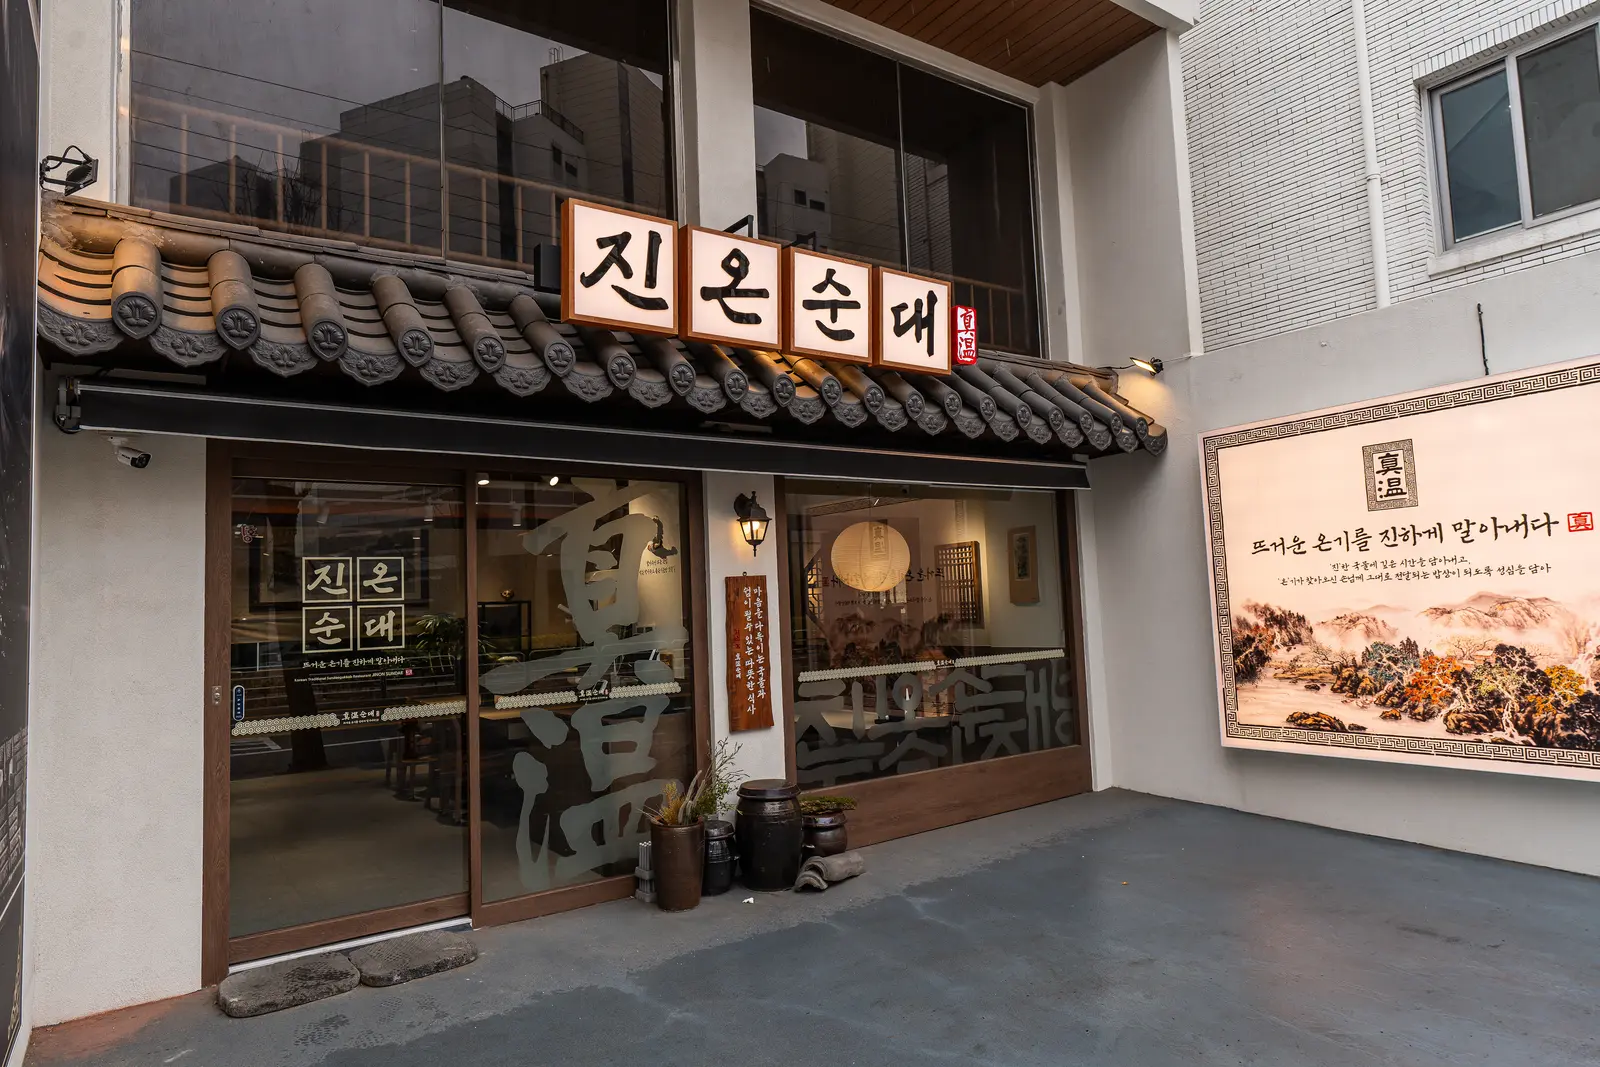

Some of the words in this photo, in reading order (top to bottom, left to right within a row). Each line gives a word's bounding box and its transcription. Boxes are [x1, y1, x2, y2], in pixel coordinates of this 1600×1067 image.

[1251, 536, 1308, 556] 뜨거운
[1312, 527, 1374, 553] 온기를
[1378, 522, 1445, 549] 진하게
[1452, 511, 1560, 542] 말아내다
